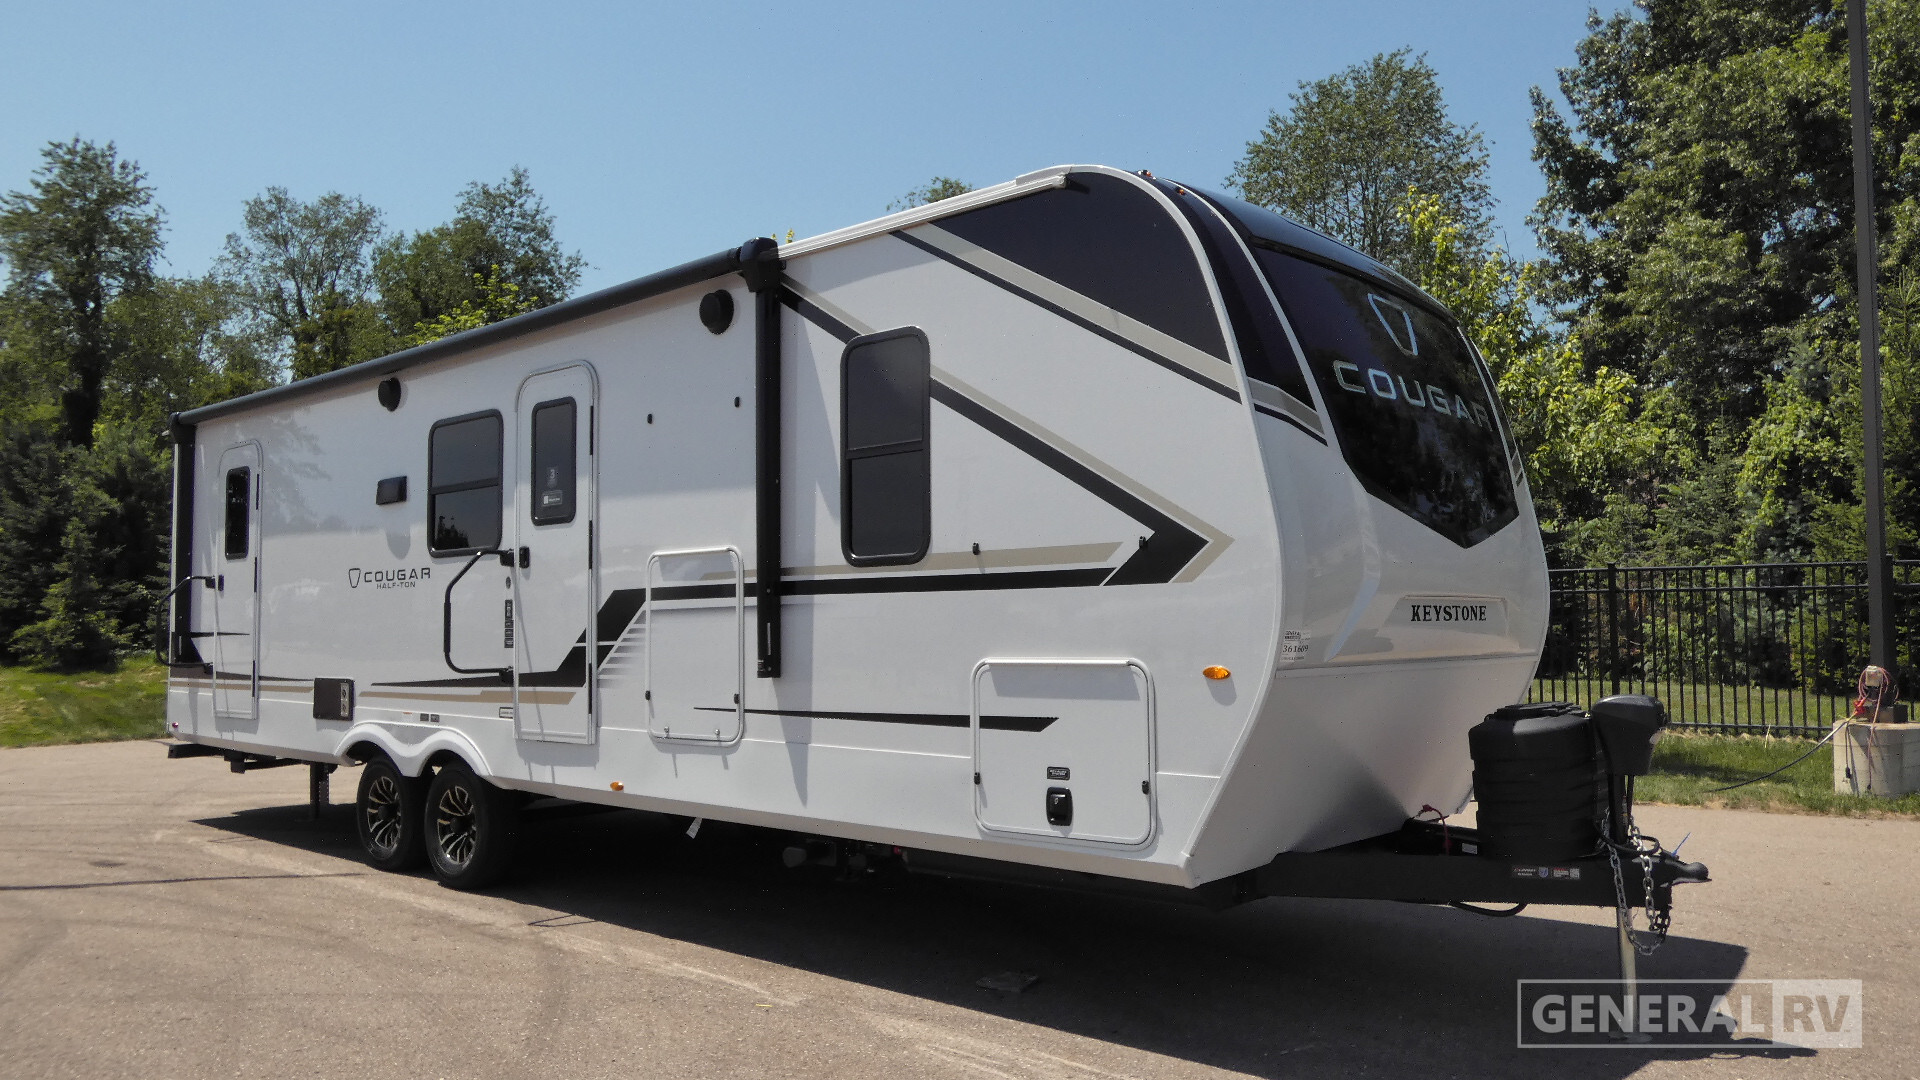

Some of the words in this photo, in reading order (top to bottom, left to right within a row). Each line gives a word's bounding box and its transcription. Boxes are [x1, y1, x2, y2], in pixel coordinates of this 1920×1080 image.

[1333, 359, 1493, 432] COUGAR
[364, 567, 431, 583] COUGAR
[376, 581, 416, 590] HALF-TON
[1411, 605, 1487, 622] KEYSTONE
